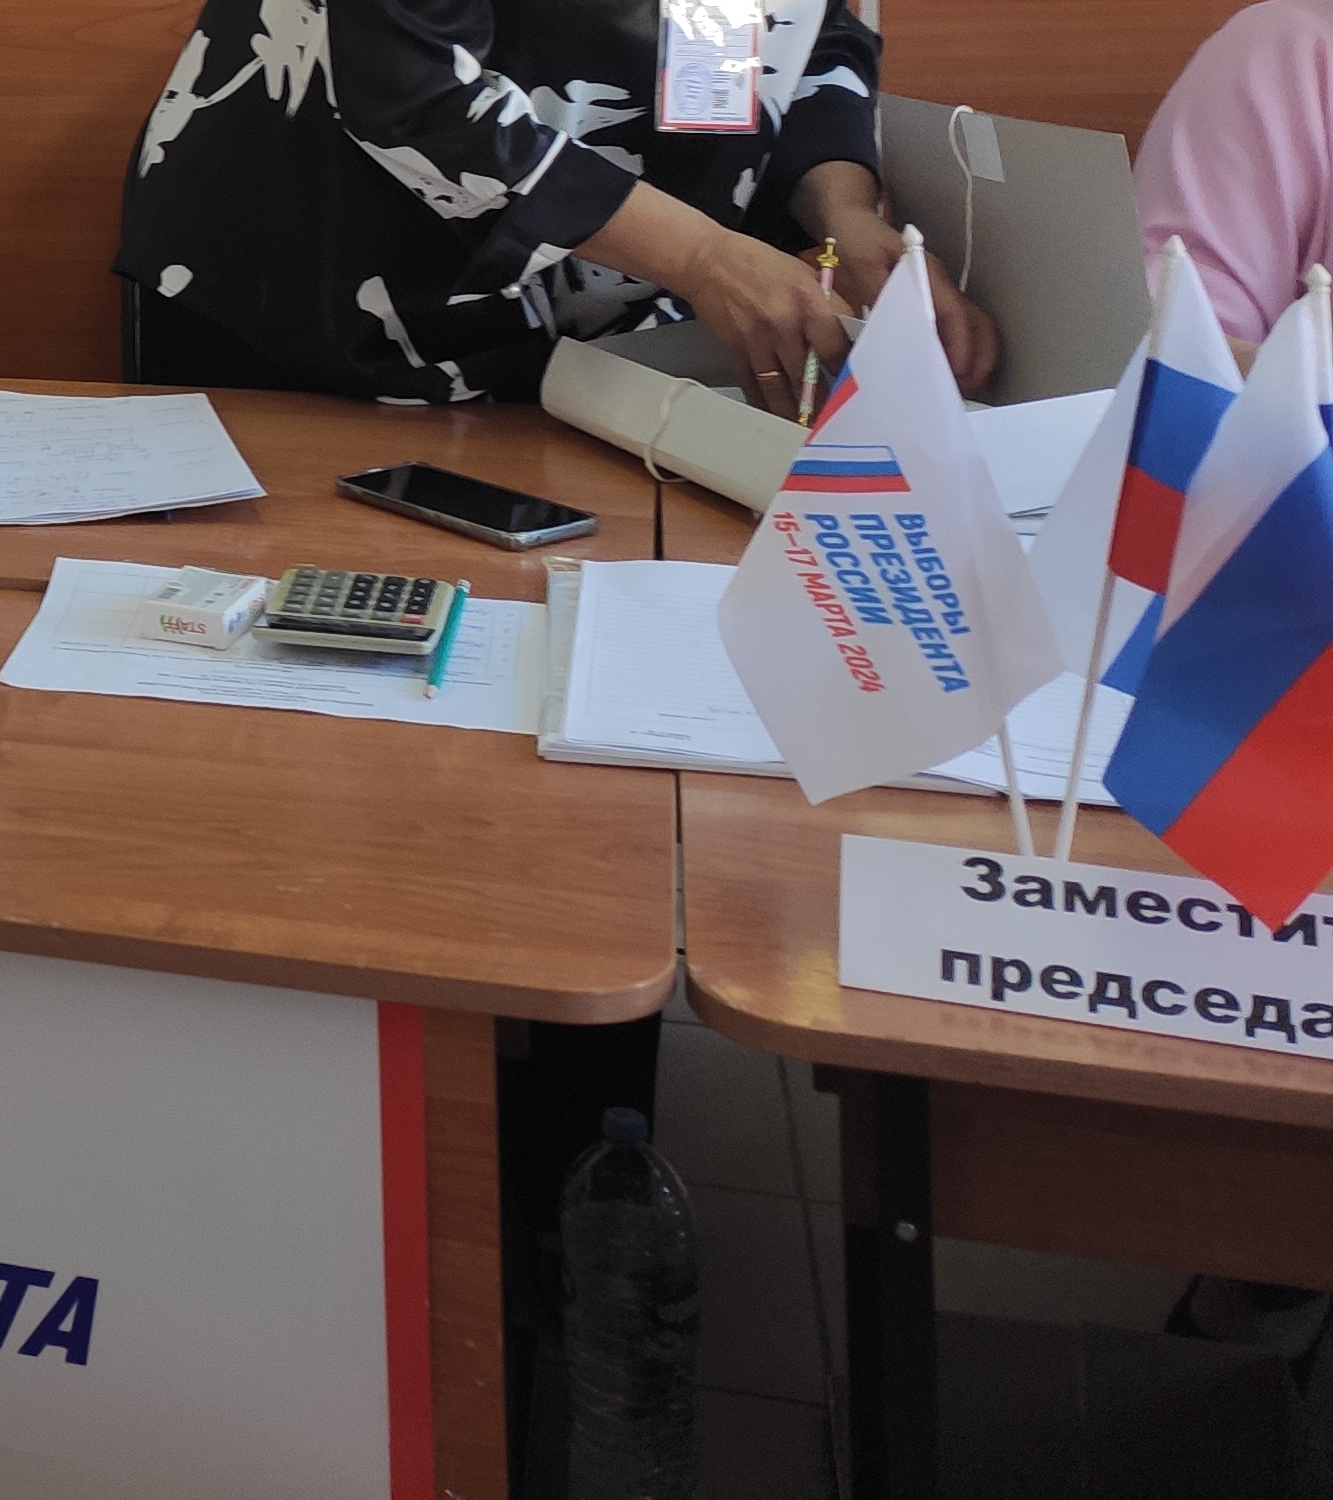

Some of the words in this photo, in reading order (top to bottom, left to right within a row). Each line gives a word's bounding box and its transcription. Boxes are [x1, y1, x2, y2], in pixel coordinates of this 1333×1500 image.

[804, 512, 894, 626] РОССИИ
[849, 513, 971, 694] ПРЕЗИДЕНТА
[893, 513, 971, 635] ВЫБОРЫ
[796, 572, 857, 639] МАРТА
[837, 643, 886, 694] 2024
[961, 856, 1333, 948] Замести
[939, 947, 1333, 1044] председа
